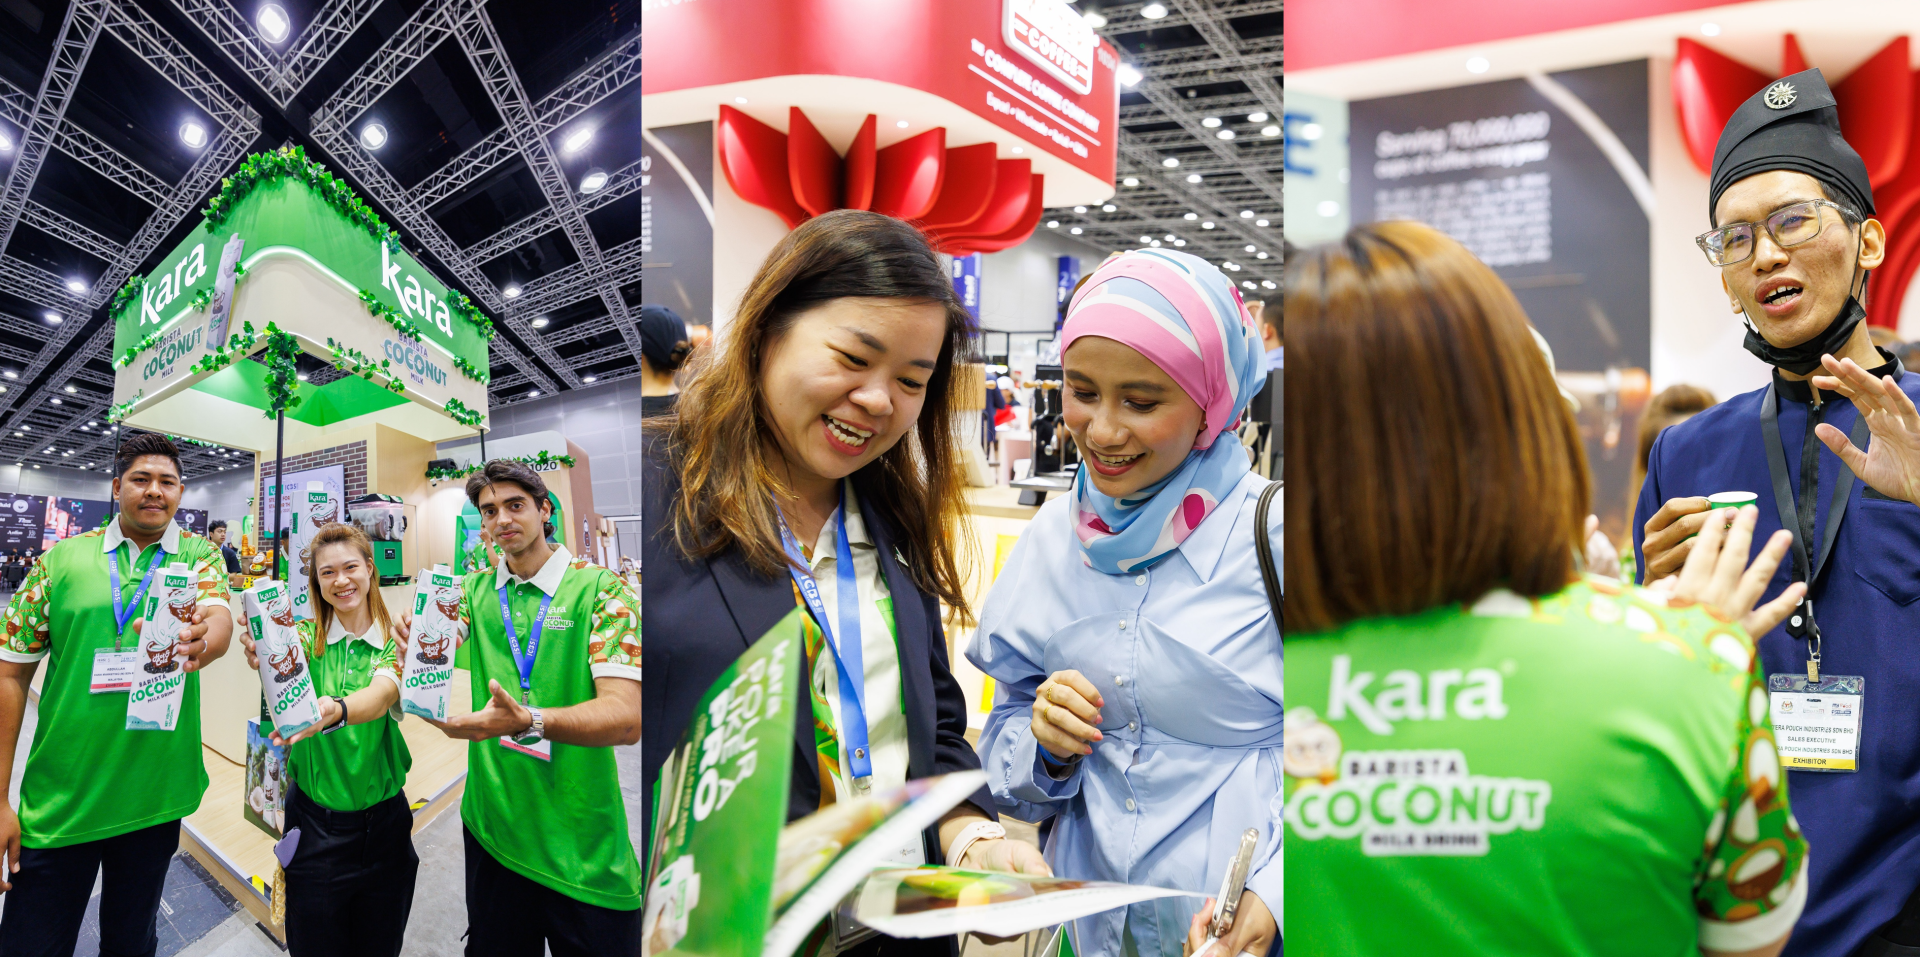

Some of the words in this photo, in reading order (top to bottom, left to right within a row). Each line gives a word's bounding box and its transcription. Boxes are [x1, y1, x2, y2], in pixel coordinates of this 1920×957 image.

[140, 243, 207, 327] kara
[381, 241, 453, 339] kara
[155, 326, 182, 353] BARISTA
[398, 330, 429, 358] BARISTA
[143, 325, 203, 381] COCONUT
[384, 338, 447, 387] COCONUT
[161, 366, 174, 379] MILK
[410, 371, 424, 386] MILK
[310, 494, 326, 503] kara
[166, 577, 185, 586] kara
[433, 576, 451, 586] kara
[259, 589, 277, 601] kara
[801, 575, 822, 608] ICBS
[139, 674, 166, 687] BARISTA
[406, 668, 453, 688] COCONUT
[413, 666, 438, 675] BARISTA
[131, 672, 184, 703] COCONUT
[274, 672, 310, 715] COCONU
[277, 678, 299, 699] BARISTA
[1327, 653, 1509, 736] kara
[147, 695, 160, 703] MILK
[735, 657, 766, 784] POUR
[1803, 725, 1832, 733] INDUSTRIES
[693, 688, 731, 822] PRO
[1793, 757, 1827, 765] EXHIBITOR
[1350, 759, 1459, 776] BARISTA
[1298, 782, 1542, 829] COCONUT
[1371, 834, 1415, 847] MILK
